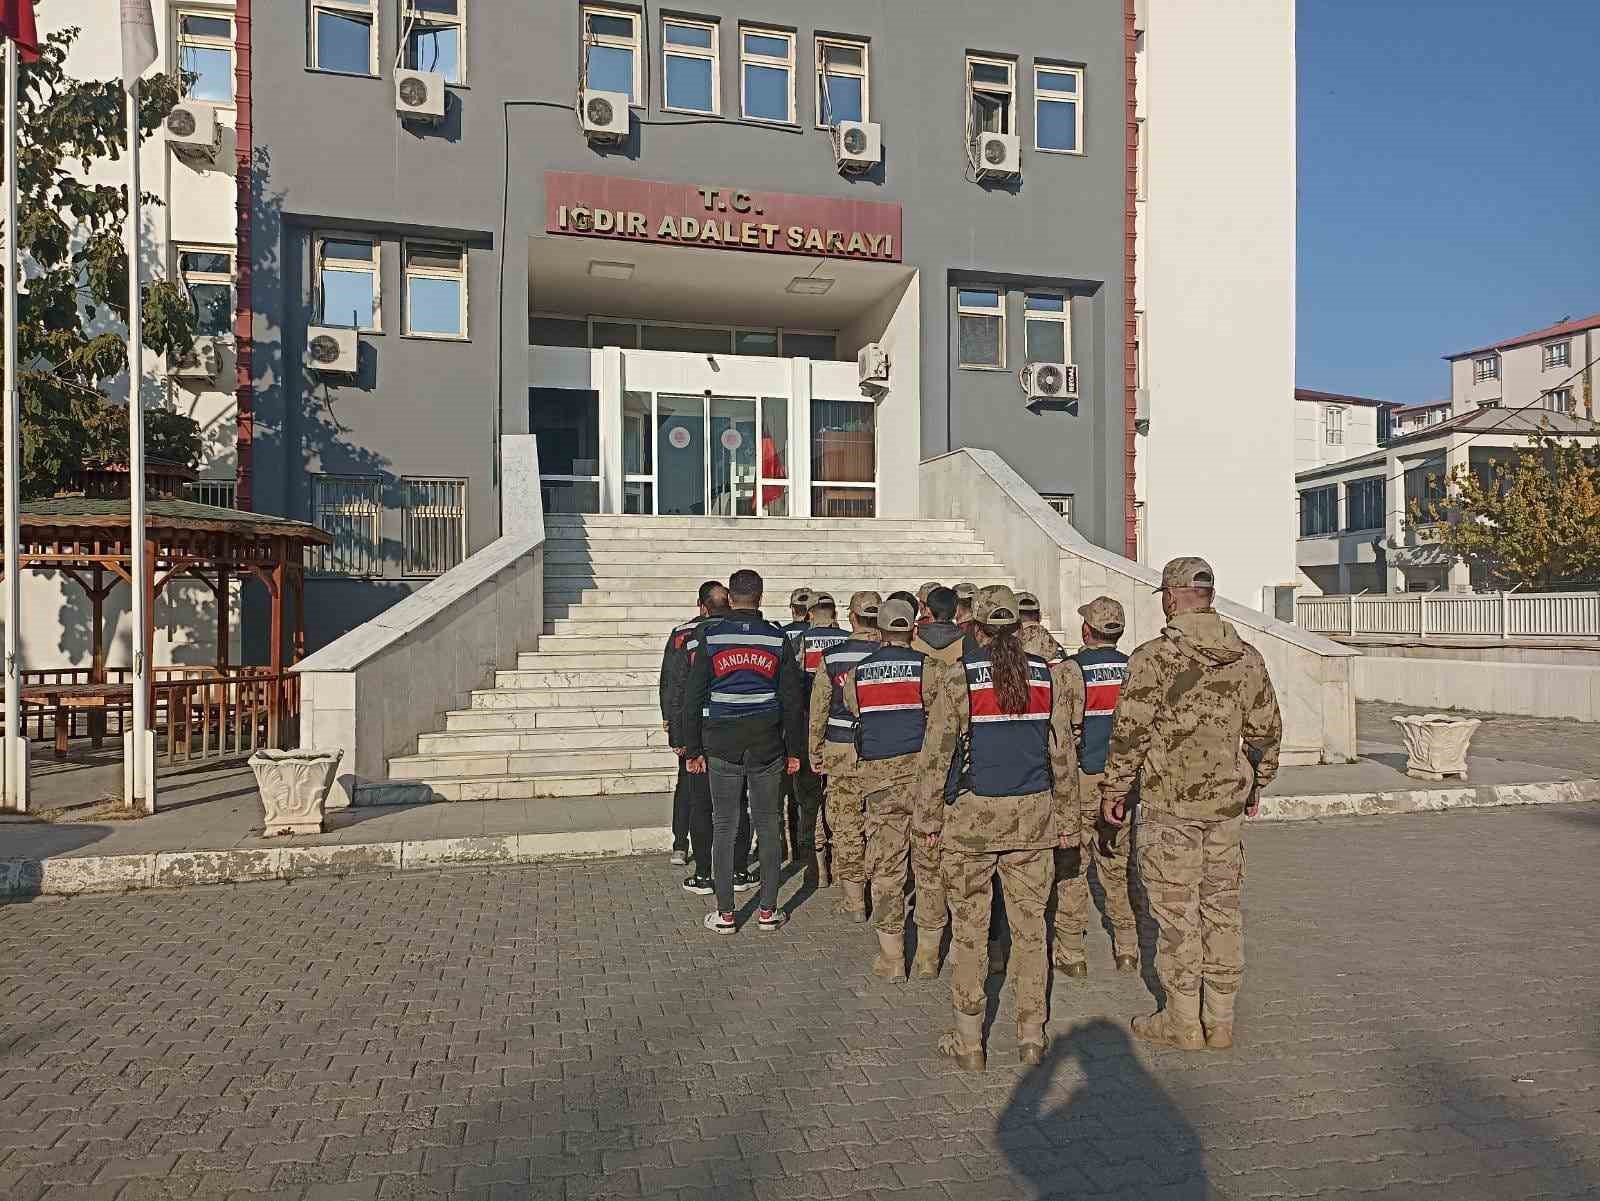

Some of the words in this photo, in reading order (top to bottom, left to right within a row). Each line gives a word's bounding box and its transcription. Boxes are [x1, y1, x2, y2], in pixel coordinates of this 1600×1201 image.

[657, 215, 779, 247] ADALET
[787, 226, 893, 257] SARAYI
[718, 653, 773, 671] JANDARMA
[861, 665, 913, 681] JANDARMA
